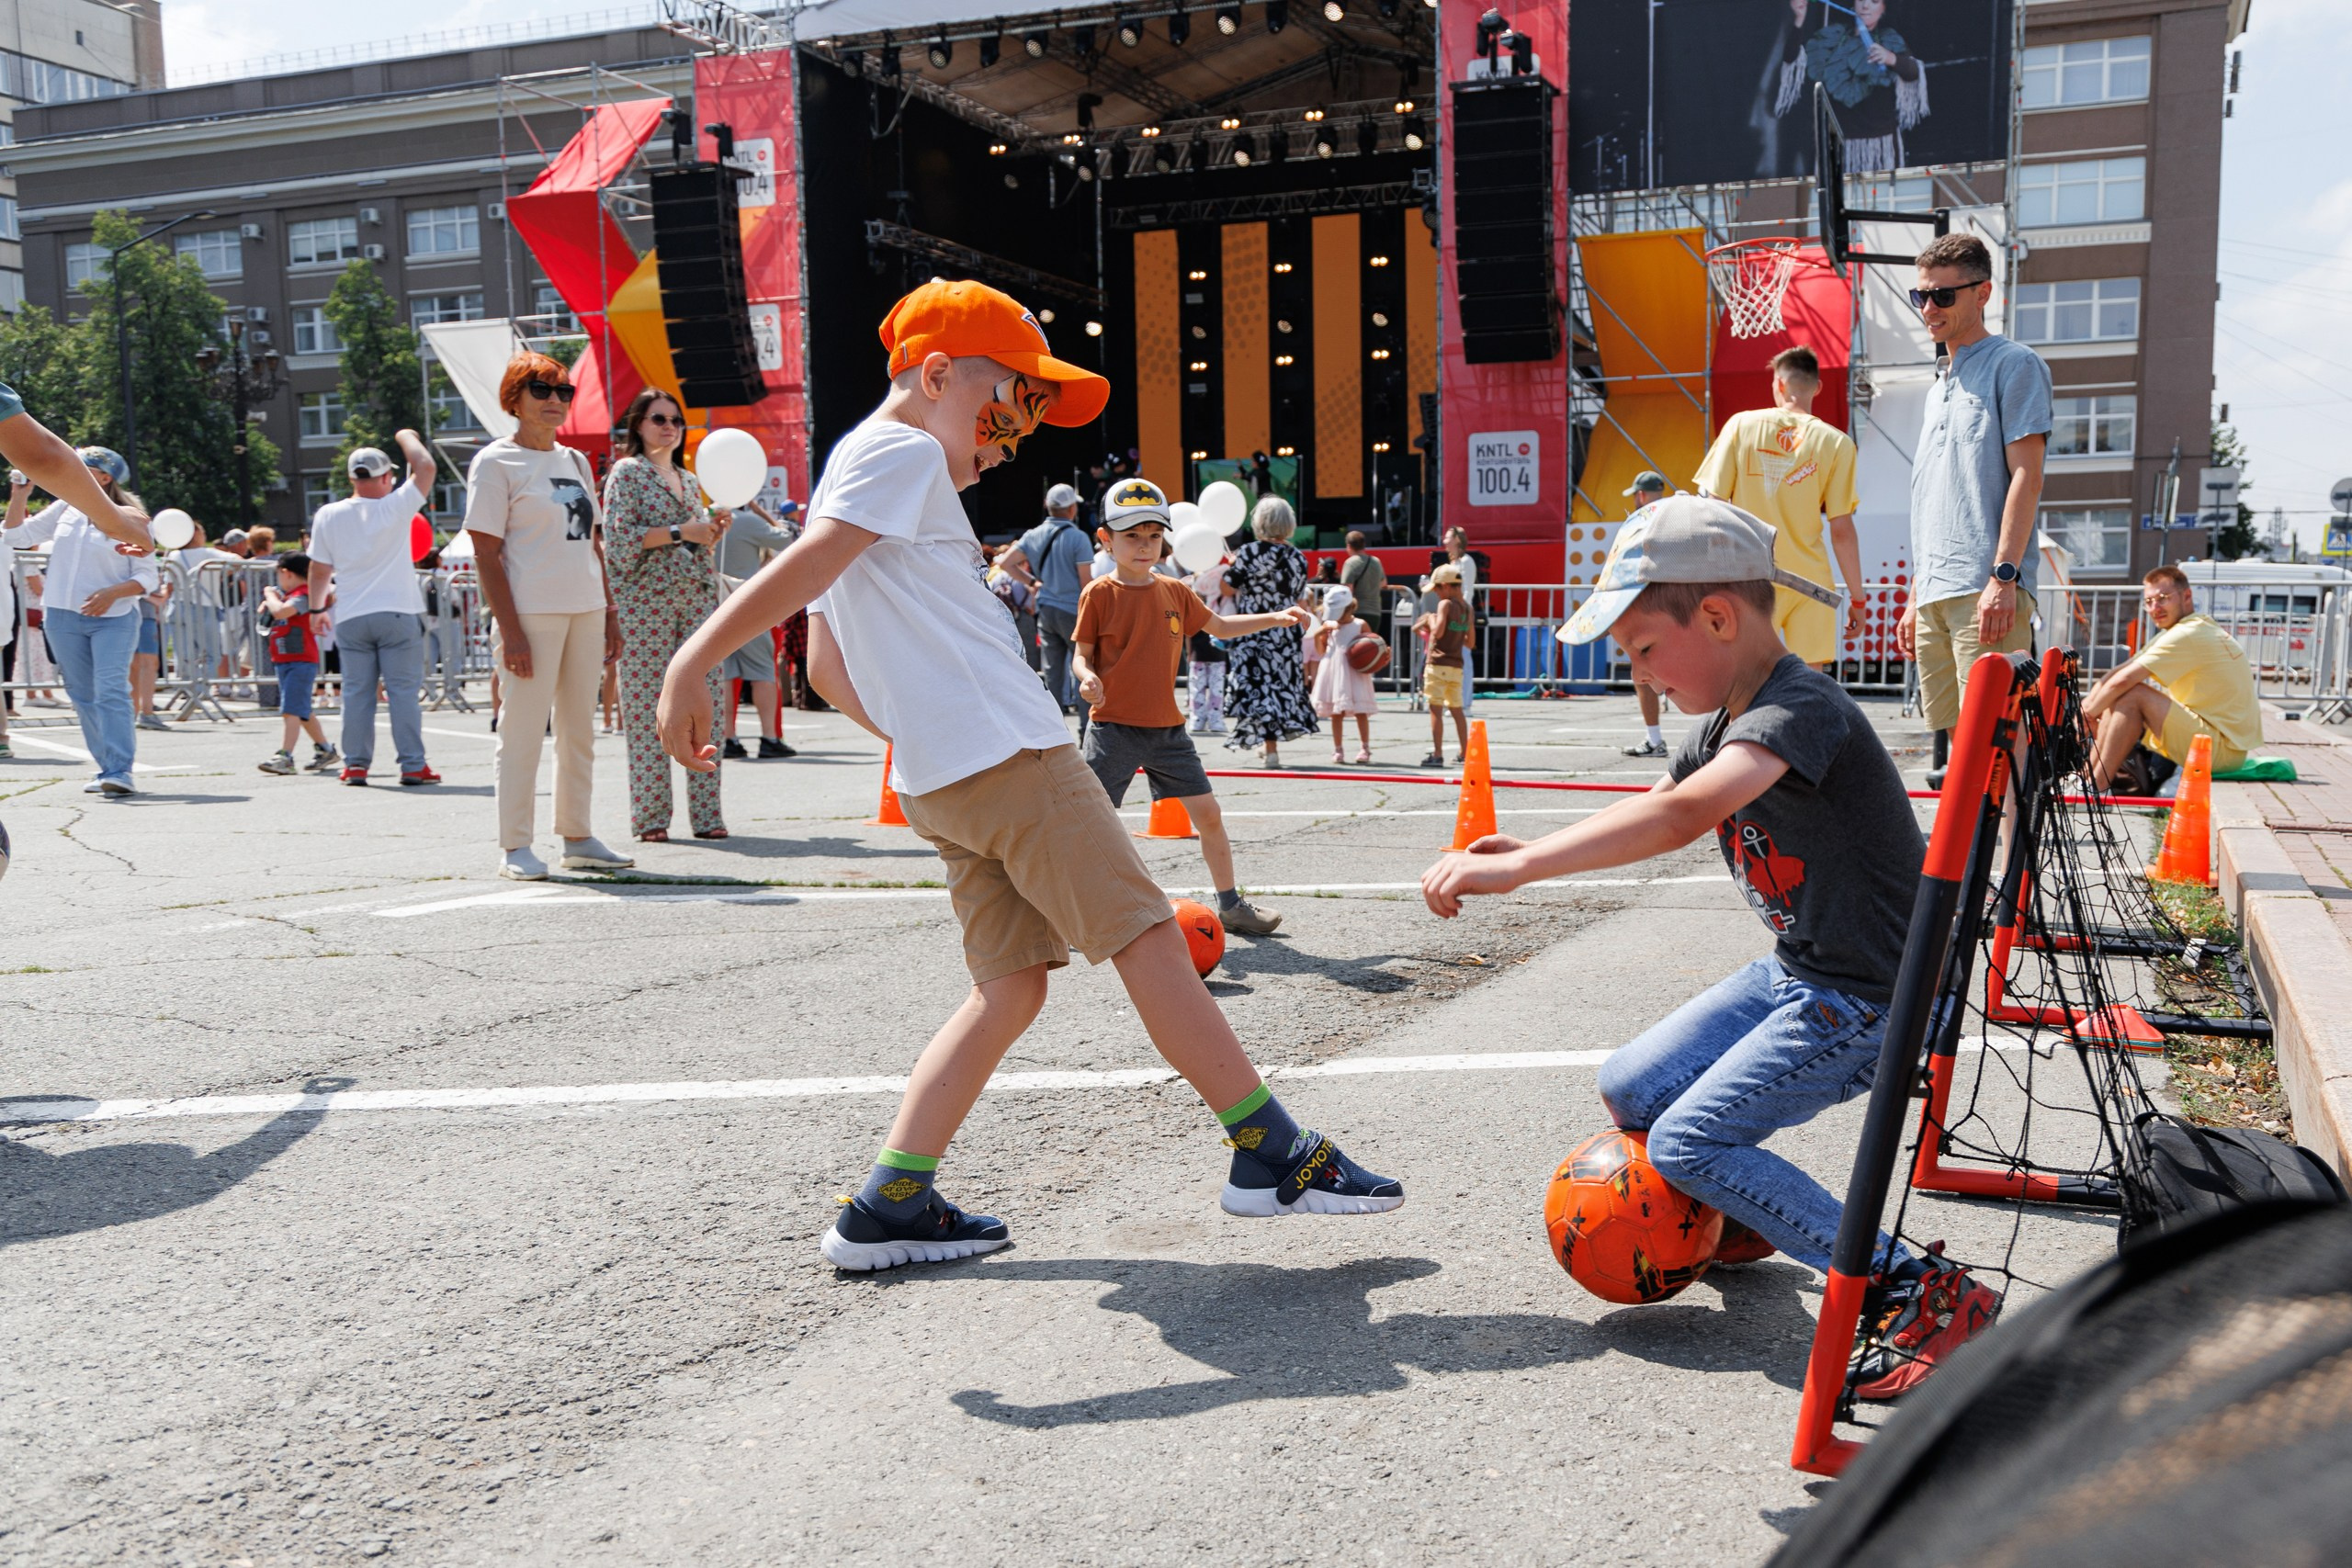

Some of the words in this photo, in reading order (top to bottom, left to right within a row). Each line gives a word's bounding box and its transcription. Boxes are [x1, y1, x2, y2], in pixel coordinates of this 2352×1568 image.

[1476, 443, 1513, 457] KNTL
[1476, 466, 1531, 494] 100.4
[1242, 1138, 1259, 1147] RISK
